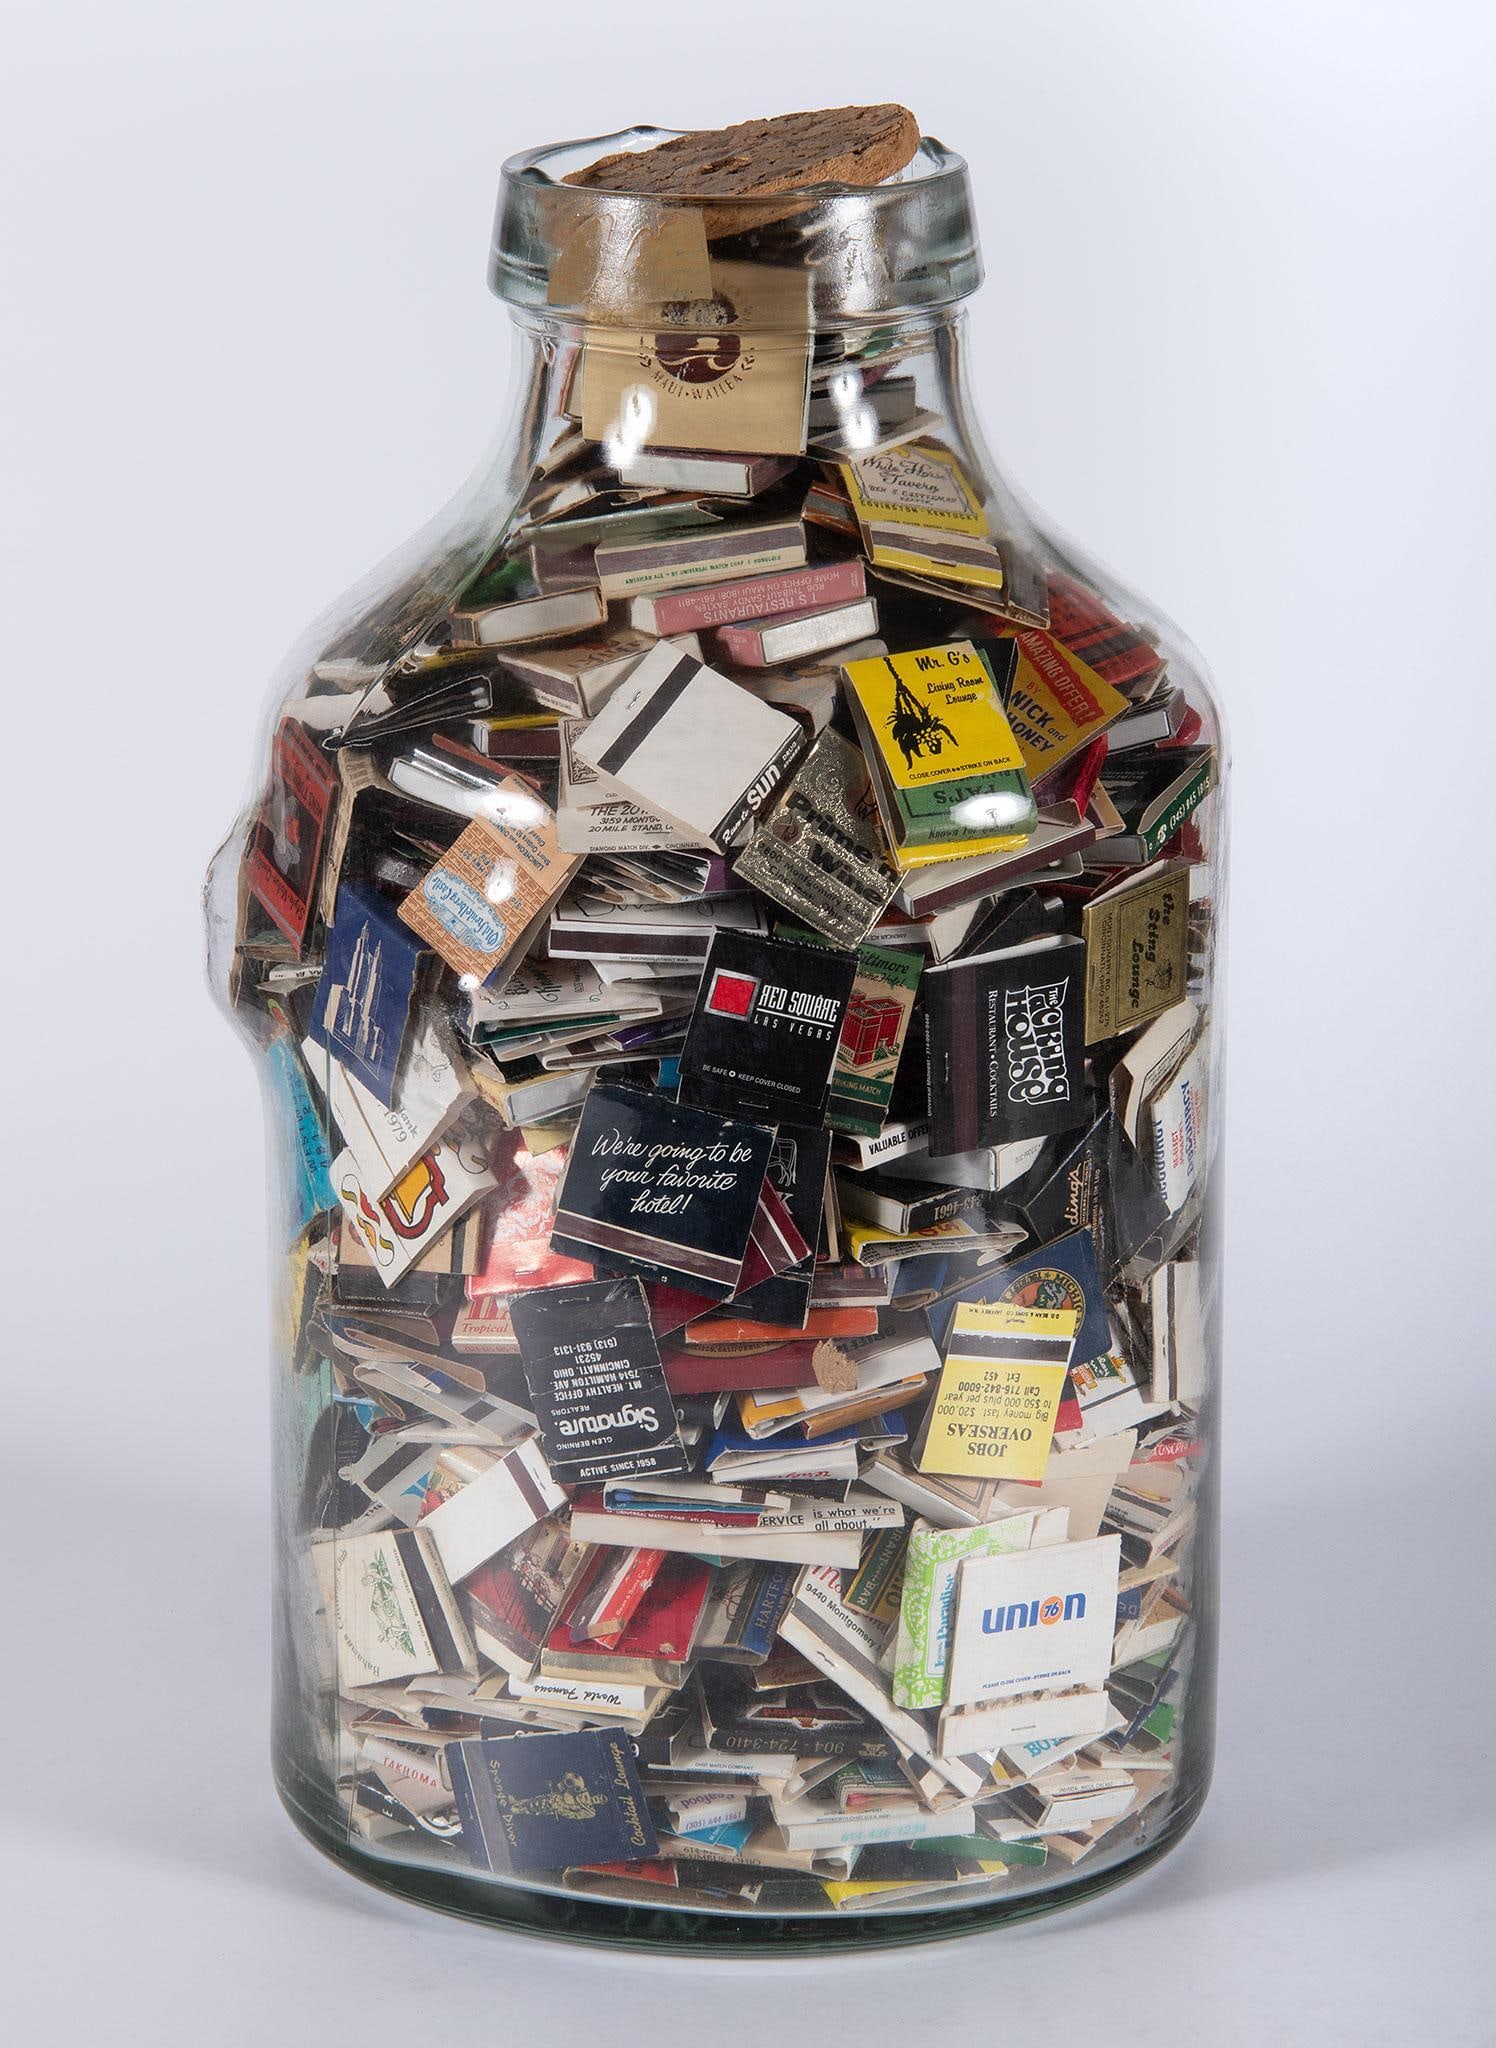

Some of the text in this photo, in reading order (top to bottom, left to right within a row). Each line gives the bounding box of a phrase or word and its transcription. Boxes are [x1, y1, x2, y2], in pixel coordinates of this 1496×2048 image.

[704, 594, 795, 624] RESTAURANTS
[914, 657, 945, 672] Mr.
[1021, 631, 1096, 721] AMAZING OFFER!
[927, 676, 984, 694] Living Room
[1026, 681, 1042, 694] BY
[945, 693, 978, 705] Lounge
[1011, 690, 1067, 741] NICK and
[590, 806, 622, 817] THE
[588, 825, 600, 833] 20
[601, 824, 628, 832] MILE
[785, 790, 873, 863] Prime
[516, 844, 545, 871] LUNCHEON
[811, 843, 882, 905] Wine
[1162, 892, 1174, 925] the
[1145, 907, 1160, 962] Sting
[1129, 939, 1144, 1008] Lounge
[754, 1014, 832, 1041] LAS VEGAS
[712, 1066, 728, 1077] SAFE
[738, 1073, 754, 1084] KEEP
[754, 1076, 776, 1088] COVER
[776, 1080, 801, 1093] CLOSED
[859, 1083, 881, 1095] MATCH
[382, 1111, 408, 1143] 1979
[591, 1128, 752, 1168] We're going to be
[868, 1131, 907, 1155] VALUABLE
[600, 1164, 737, 1192] your favorite
[630, 1189, 694, 1214] hotel!
[1064, 1162, 1082, 1225] ding's
[461, 1322, 508, 1334] Tropical
[553, 1337, 618, 1356] (513) 931-1313
[574, 1353, 602, 1364] 45231
[553, 1368, 575, 1379] OHIO
[572, 1373, 618, 1387] HAMILTON
[619, 1369, 640, 1379] 7514
[983, 1371, 999, 1381] 452
[554, 1390, 583, 1401] OFFICE
[584, 1383, 624, 1396] HEALTHY
[958, 1381, 1040, 1395] Call 716-842-6000
[944, 1393, 963, 1403] year
[968, 1396, 981, 1404] per
[984, 1396, 1002, 1408] plus
[551, 1404, 590, 1416] REALTORS
[937, 1406, 975, 1417] $20,000
[1002, 1410, 1031, 1421] money
[1035, 1412, 1048, 1422] Big
[593, 1436, 613, 1445] GLEN
[947, 1423, 1032, 1442] OVERSEAS
[968, 1442, 1008, 1457] JOBS
[580, 1457, 657, 1477] ACTIVE SINCE 1958
[812, 1505, 896, 1518] is what we're
[814, 1520, 831, 1531] all
[802, 1582, 828, 1605] 9440
[854, 1579, 878, 1608] BAR
[935, 1572, 955, 1647] Paradise
[1043, 1603, 1061, 1618] 76
[534, 1684, 621, 1706] World Famous
[726, 1737, 844, 1753] 904 724-3410
[488, 1759, 508, 1807] Sponge
[609, 1741, 647, 1847] Cocktail Lounge
